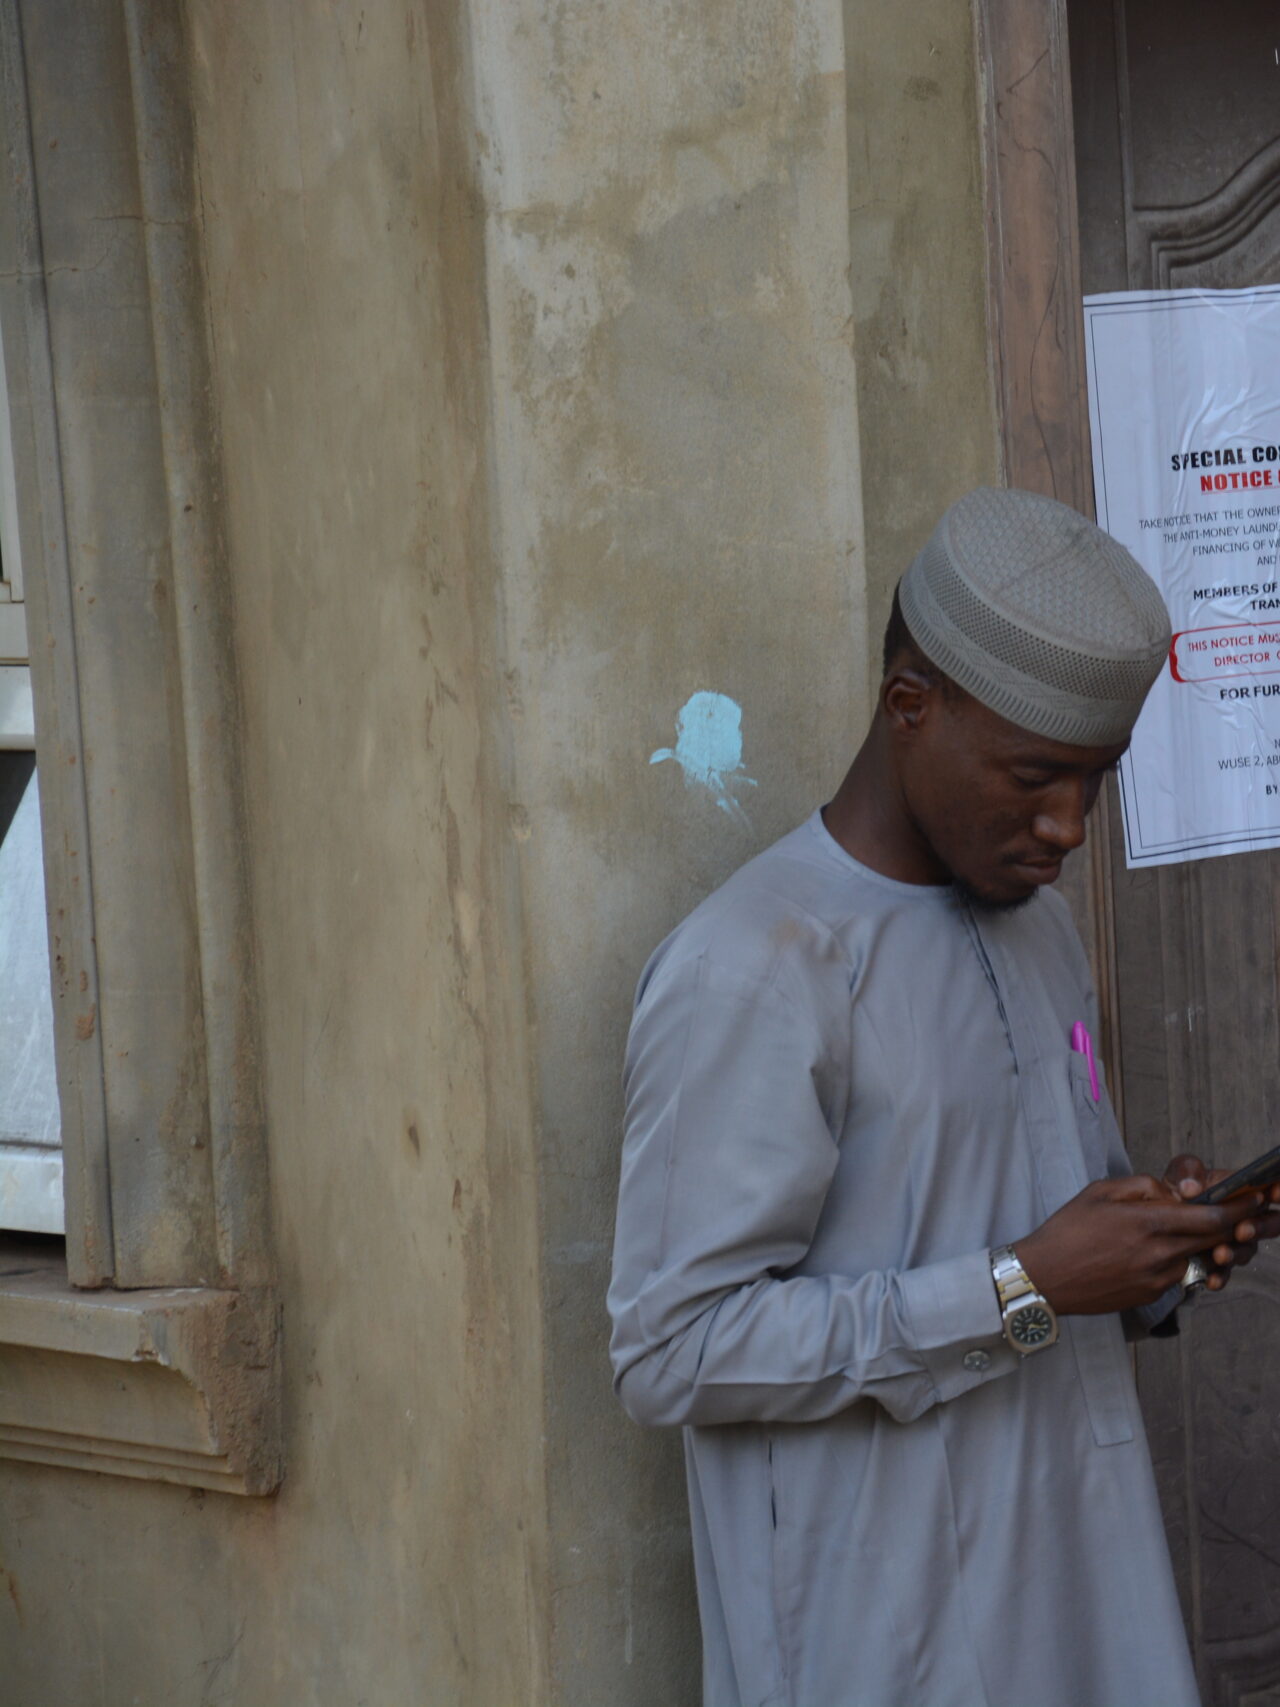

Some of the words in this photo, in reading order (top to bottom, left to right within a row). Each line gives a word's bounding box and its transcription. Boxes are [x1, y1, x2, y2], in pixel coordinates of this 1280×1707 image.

[1171, 446, 1246, 471] SPECIAL
[1200, 469, 1272, 491] NOTICE
[1139, 518, 1162, 530] TAKE
[1163, 513, 1191, 528] NOTICE
[1193, 511, 1218, 523] THAT
[1222, 509, 1243, 521] THE
[1163, 532, 1177, 544] THE
[1179, 525, 1239, 541] ANTI-MONEY
[1192, 541, 1249, 556] FINANCING
[1252, 539, 1265, 551] OF
[1256, 554, 1276, 566] AND
[1192, 583, 1259, 600] MEMBERS
[1262, 581, 1278, 594] OF
[1187, 640, 1207, 652] THIS
[1210, 634, 1254, 649] NOTICE
[1214, 651, 1270, 667] DIRECTOR
[1219, 686, 1250, 700] FOR
[1217, 757, 1250, 770] WUSE
[1254, 756, 1263, 768] 2,
[1265, 784, 1278, 795] BY
